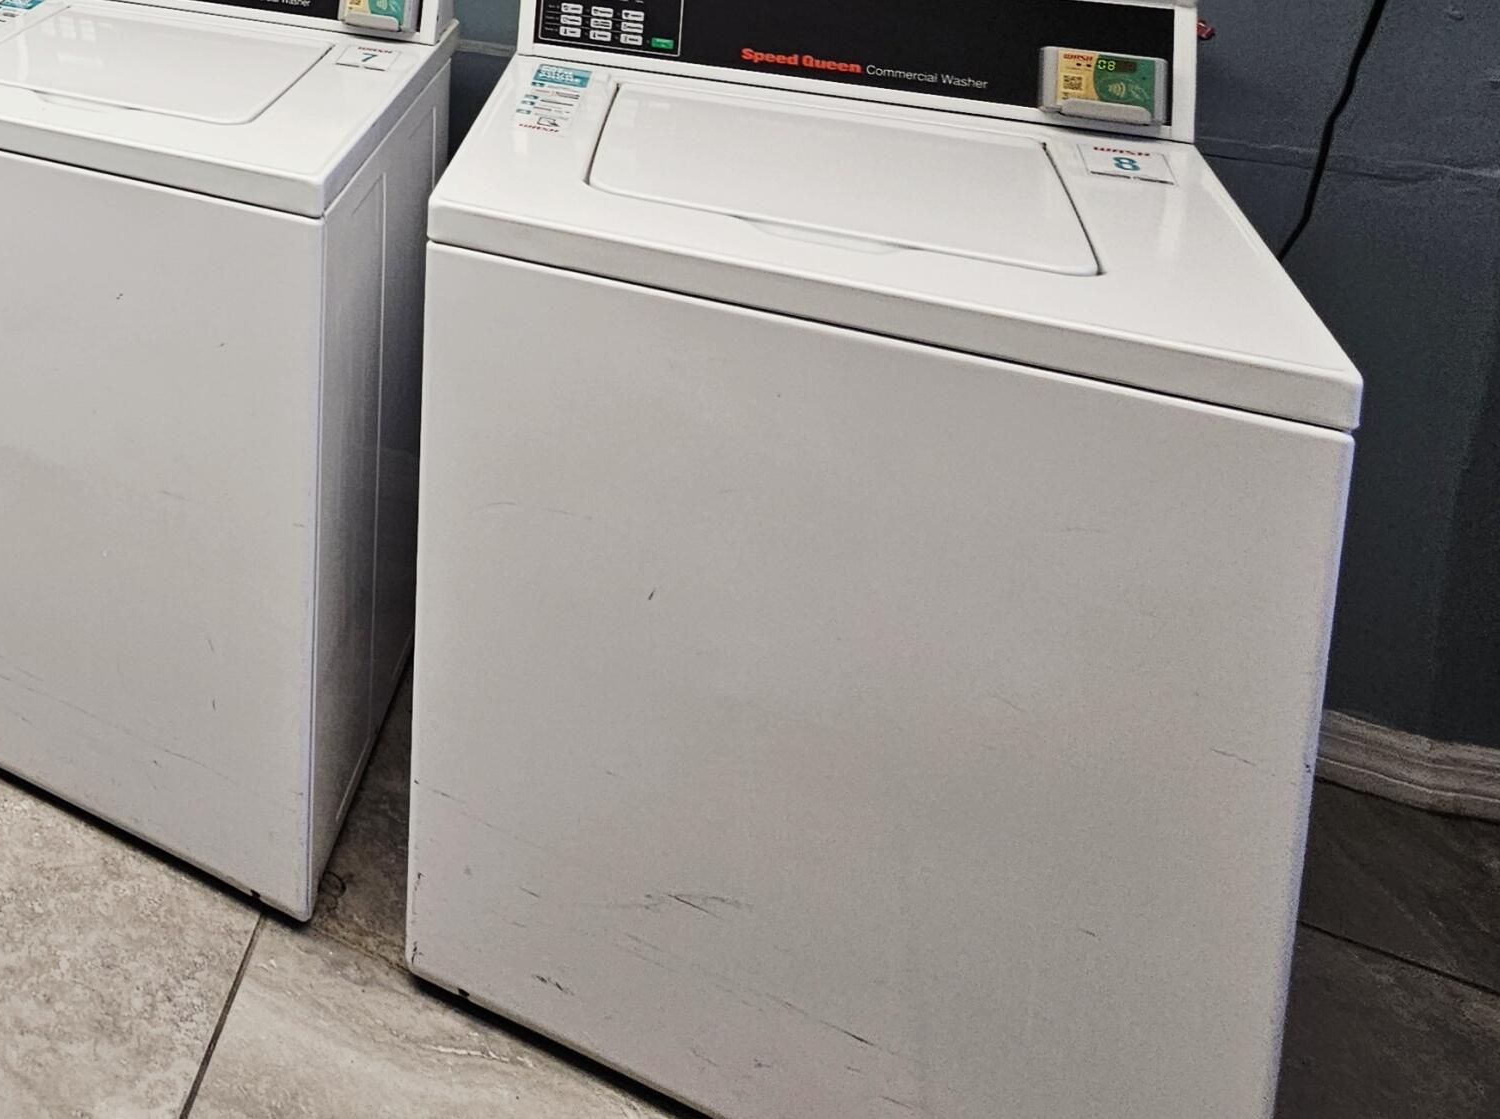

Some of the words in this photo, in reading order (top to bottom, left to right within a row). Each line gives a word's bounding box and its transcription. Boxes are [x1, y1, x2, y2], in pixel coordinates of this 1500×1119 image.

[361, 52, 378, 62] 7
[1063, 52, 1094, 63] WASH
[741, 47, 799, 69] Speed
[802, 53, 862, 74] Queen
[866, 63, 938, 84] Commercial
[941, 72, 988, 90] Washer
[1093, 146, 1151, 157] WASH
[1112, 156, 1141, 172] 8
